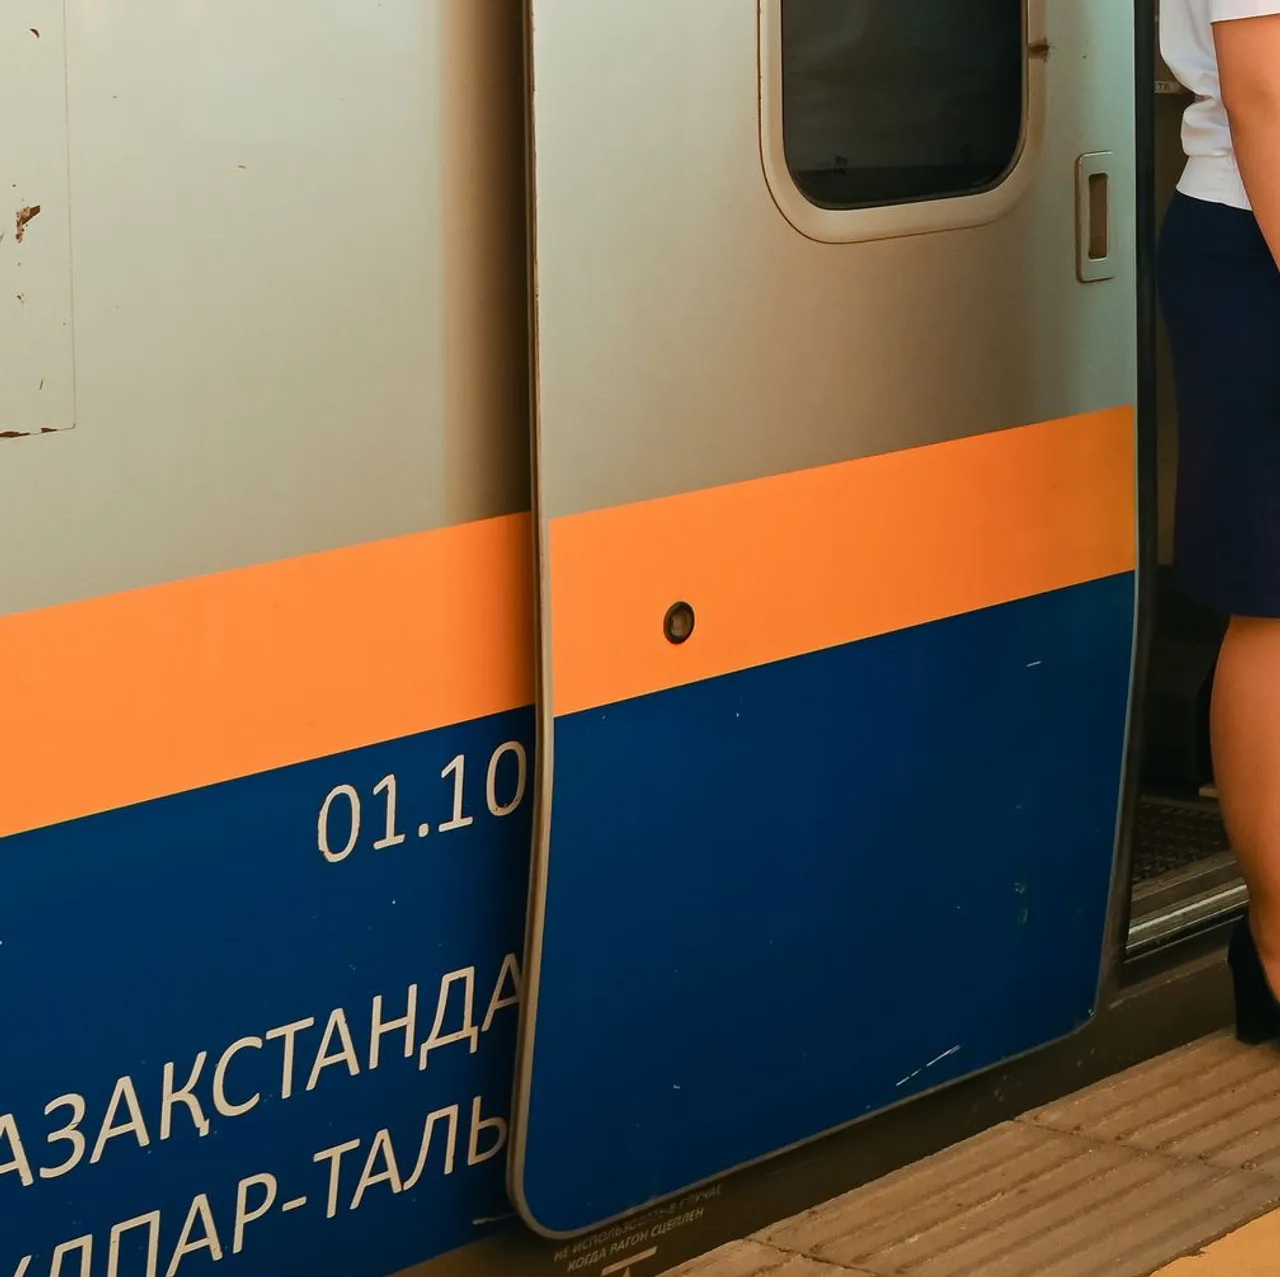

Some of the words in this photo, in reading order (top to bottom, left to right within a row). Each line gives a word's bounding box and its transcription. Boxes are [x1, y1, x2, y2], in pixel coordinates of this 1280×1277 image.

[316, 740, 528, 863] 01.10
[13, 1095, 509, 1277] ЛПАР-ТАЛЬ
[567, 1250, 607, 1273] КОГДА
